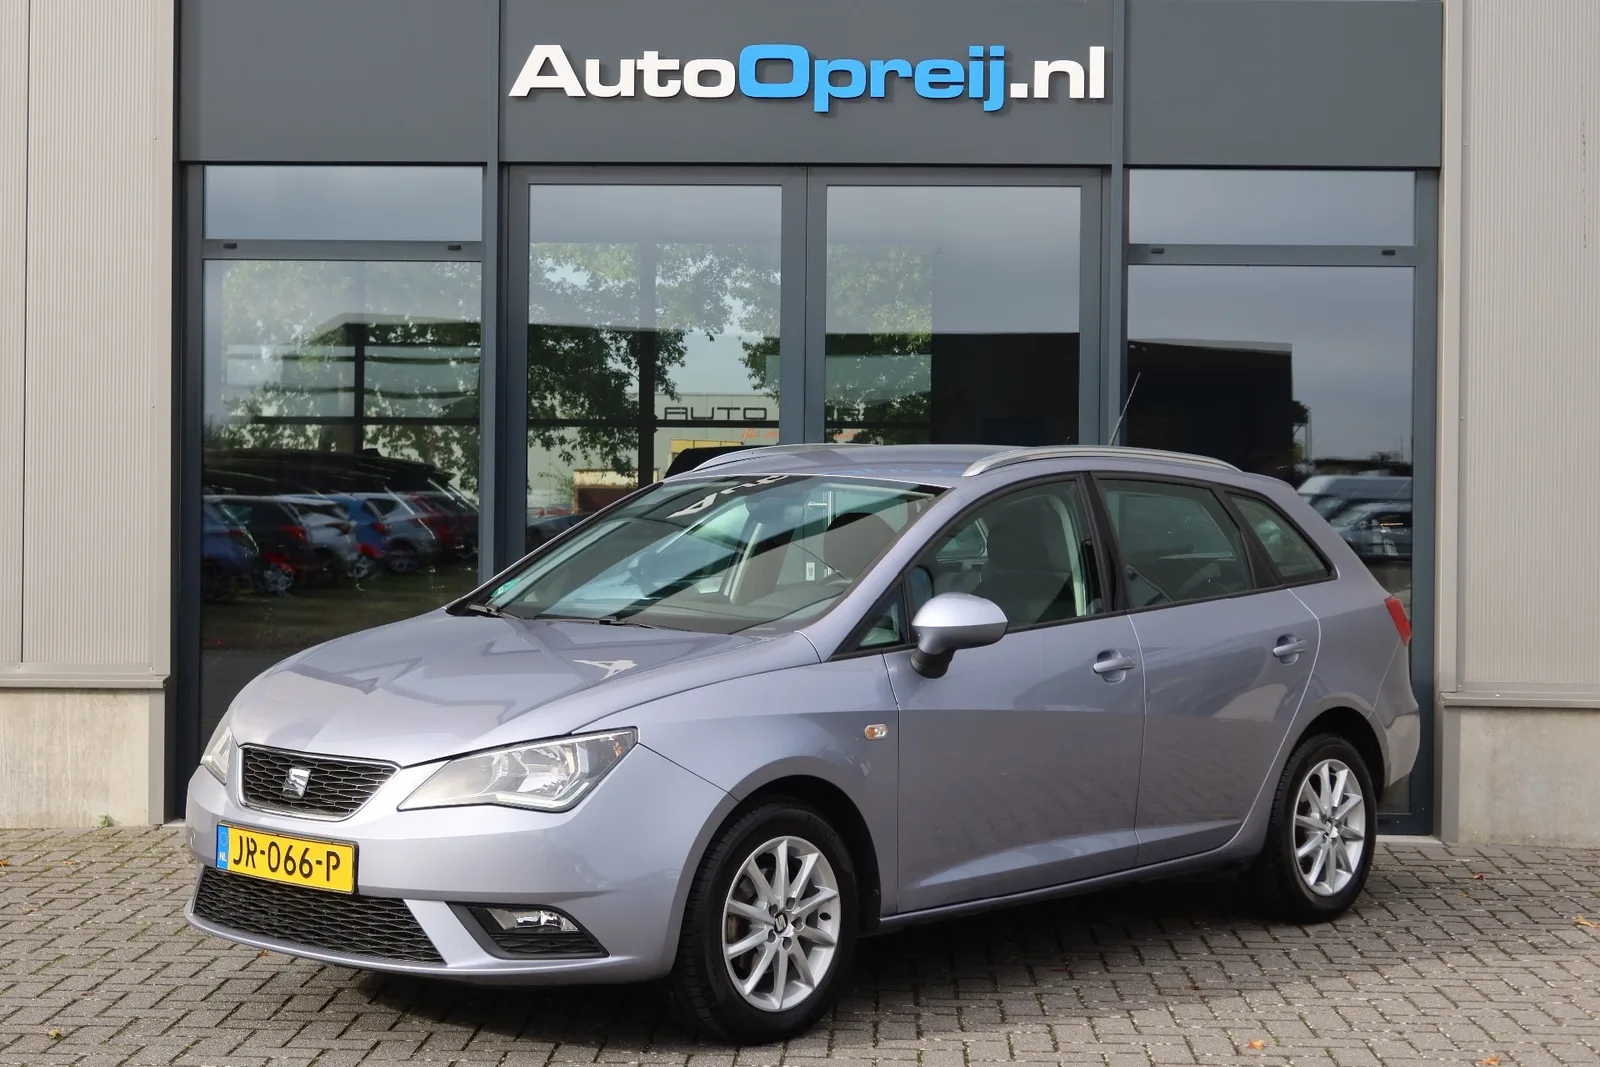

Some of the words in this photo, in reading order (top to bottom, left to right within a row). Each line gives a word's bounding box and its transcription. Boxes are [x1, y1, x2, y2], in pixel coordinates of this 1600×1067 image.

[509, 44, 1105, 112] AutoOpreij.nl
[664, 407, 767, 420] AUTO
[219, 851, 227, 862] NL
[233, 835, 341, 881] JR-066-P
